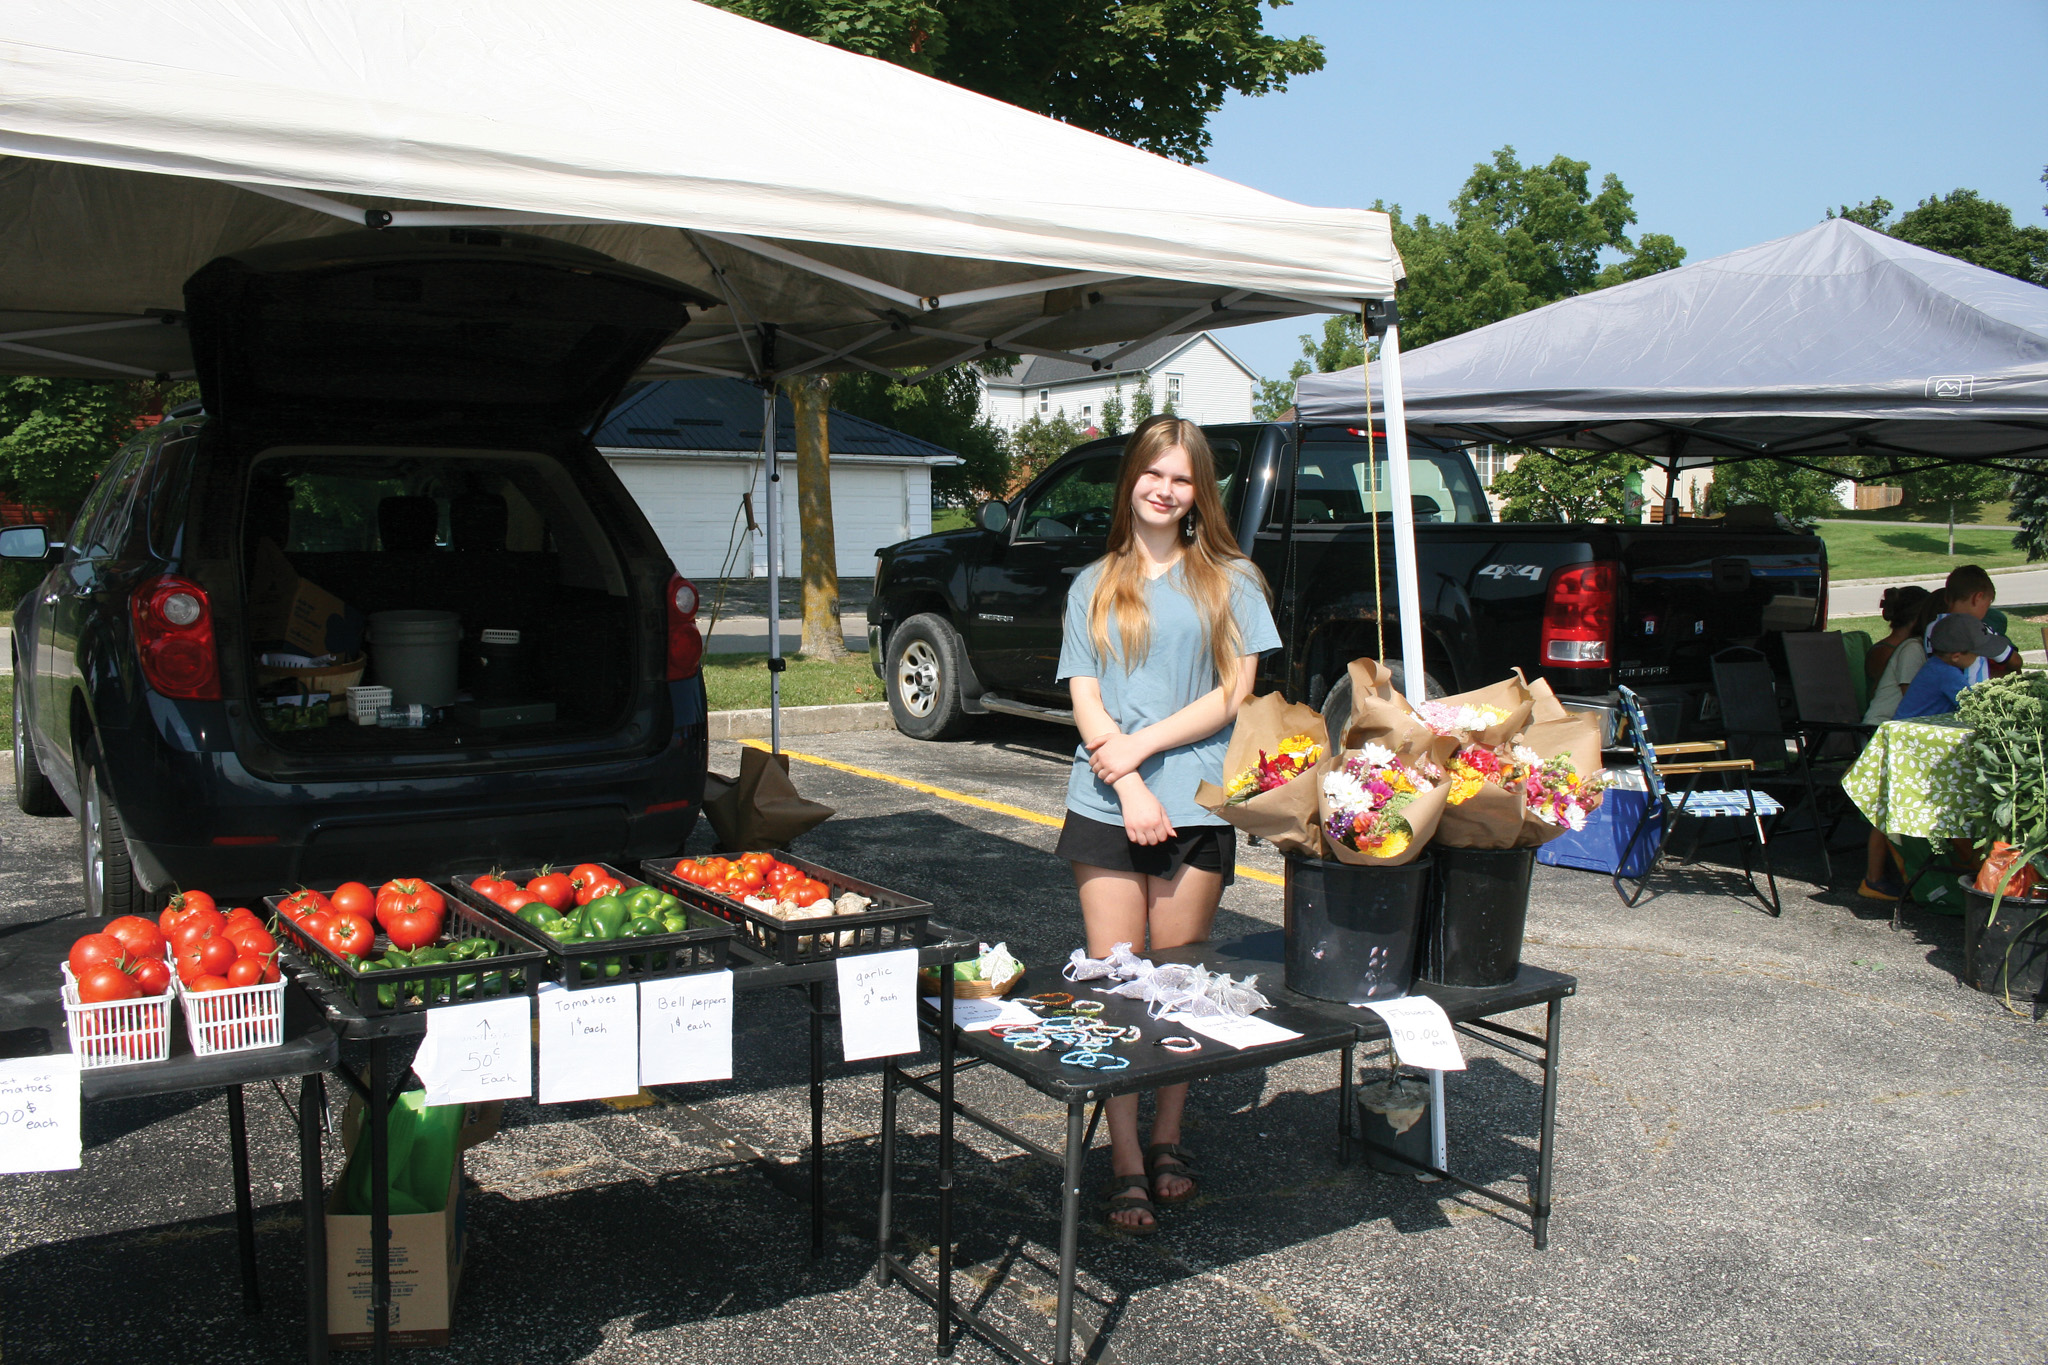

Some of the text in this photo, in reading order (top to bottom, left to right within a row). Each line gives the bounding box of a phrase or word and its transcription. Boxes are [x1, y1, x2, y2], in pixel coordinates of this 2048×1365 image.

[856, 967, 893, 987] garlic
[555, 995, 617, 1012] Tomatoes
[658, 996, 728, 1011] Bell peppers
[880, 993, 898, 1002] each
[583, 1022, 608, 1035] each
[687, 1020, 713, 1032] each
[480, 1072, 518, 1086] Each
[26, 1118, 59, 1130] each
